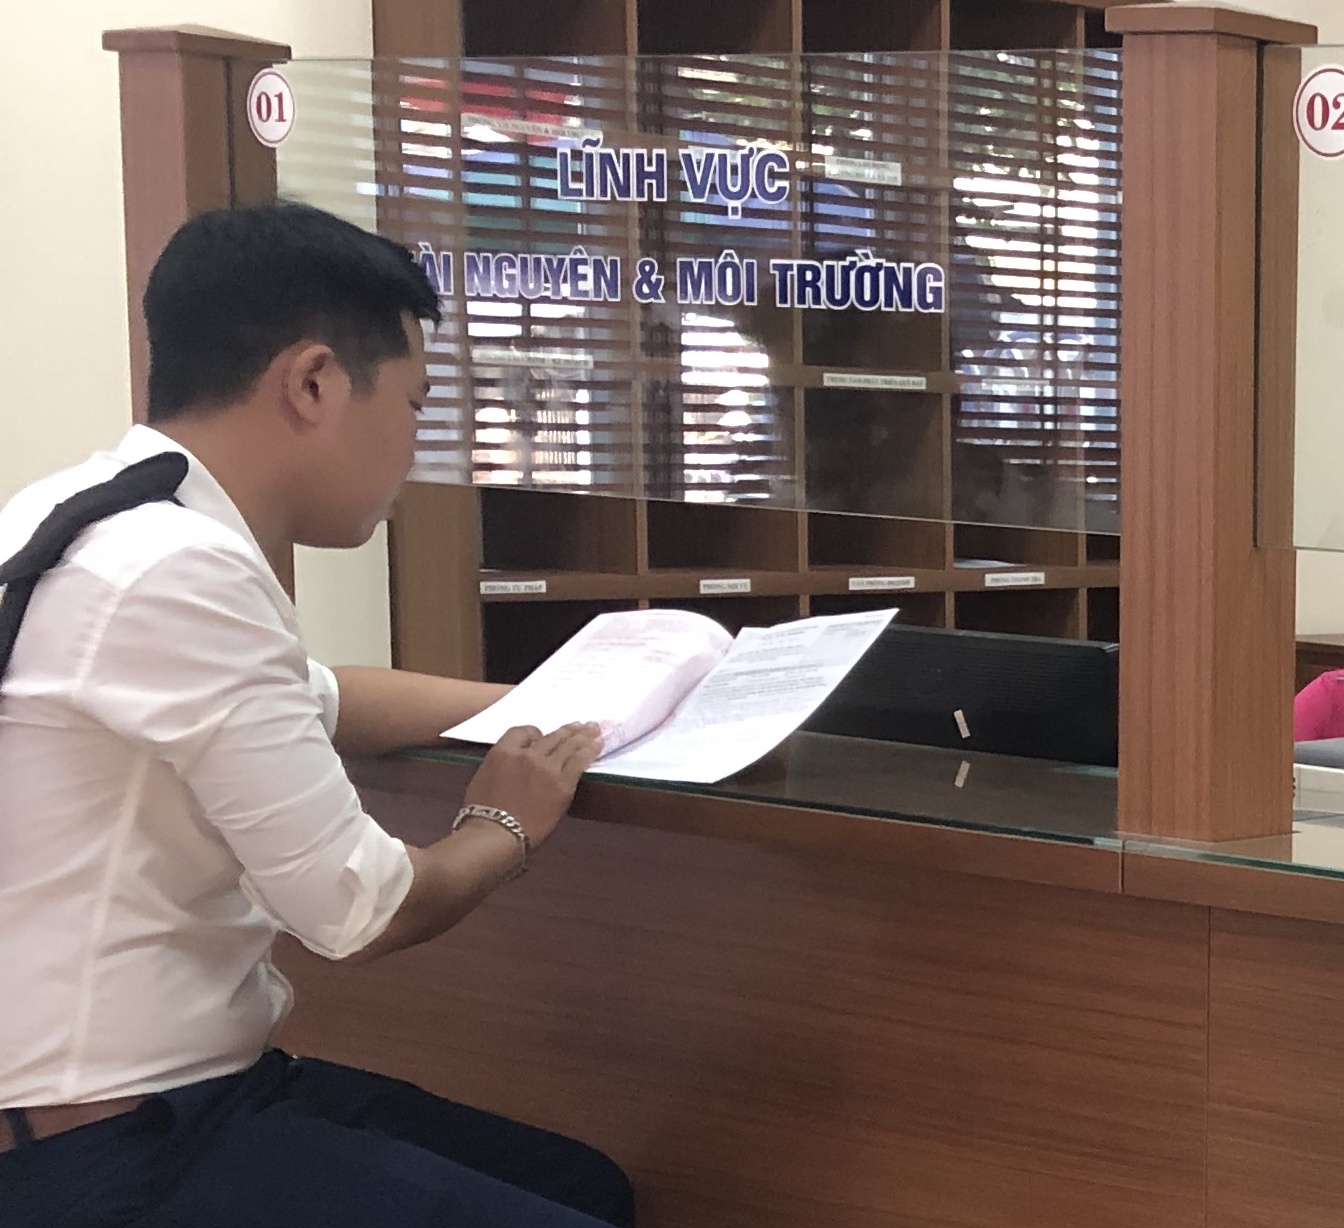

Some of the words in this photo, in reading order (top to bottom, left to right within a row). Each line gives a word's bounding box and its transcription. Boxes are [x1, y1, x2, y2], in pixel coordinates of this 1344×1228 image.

[256, 91, 288, 123] 01
[557, 138, 667, 201] LĨNH
[679, 146, 790, 219] VỰC
[413, 241, 454, 296] ÀI
[464, 245, 621, 300] NGUYÊN
[633, 257, 665, 304] &
[677, 249, 758, 305] MÔI
[770, 249, 944, 313] TRƯỜNG
